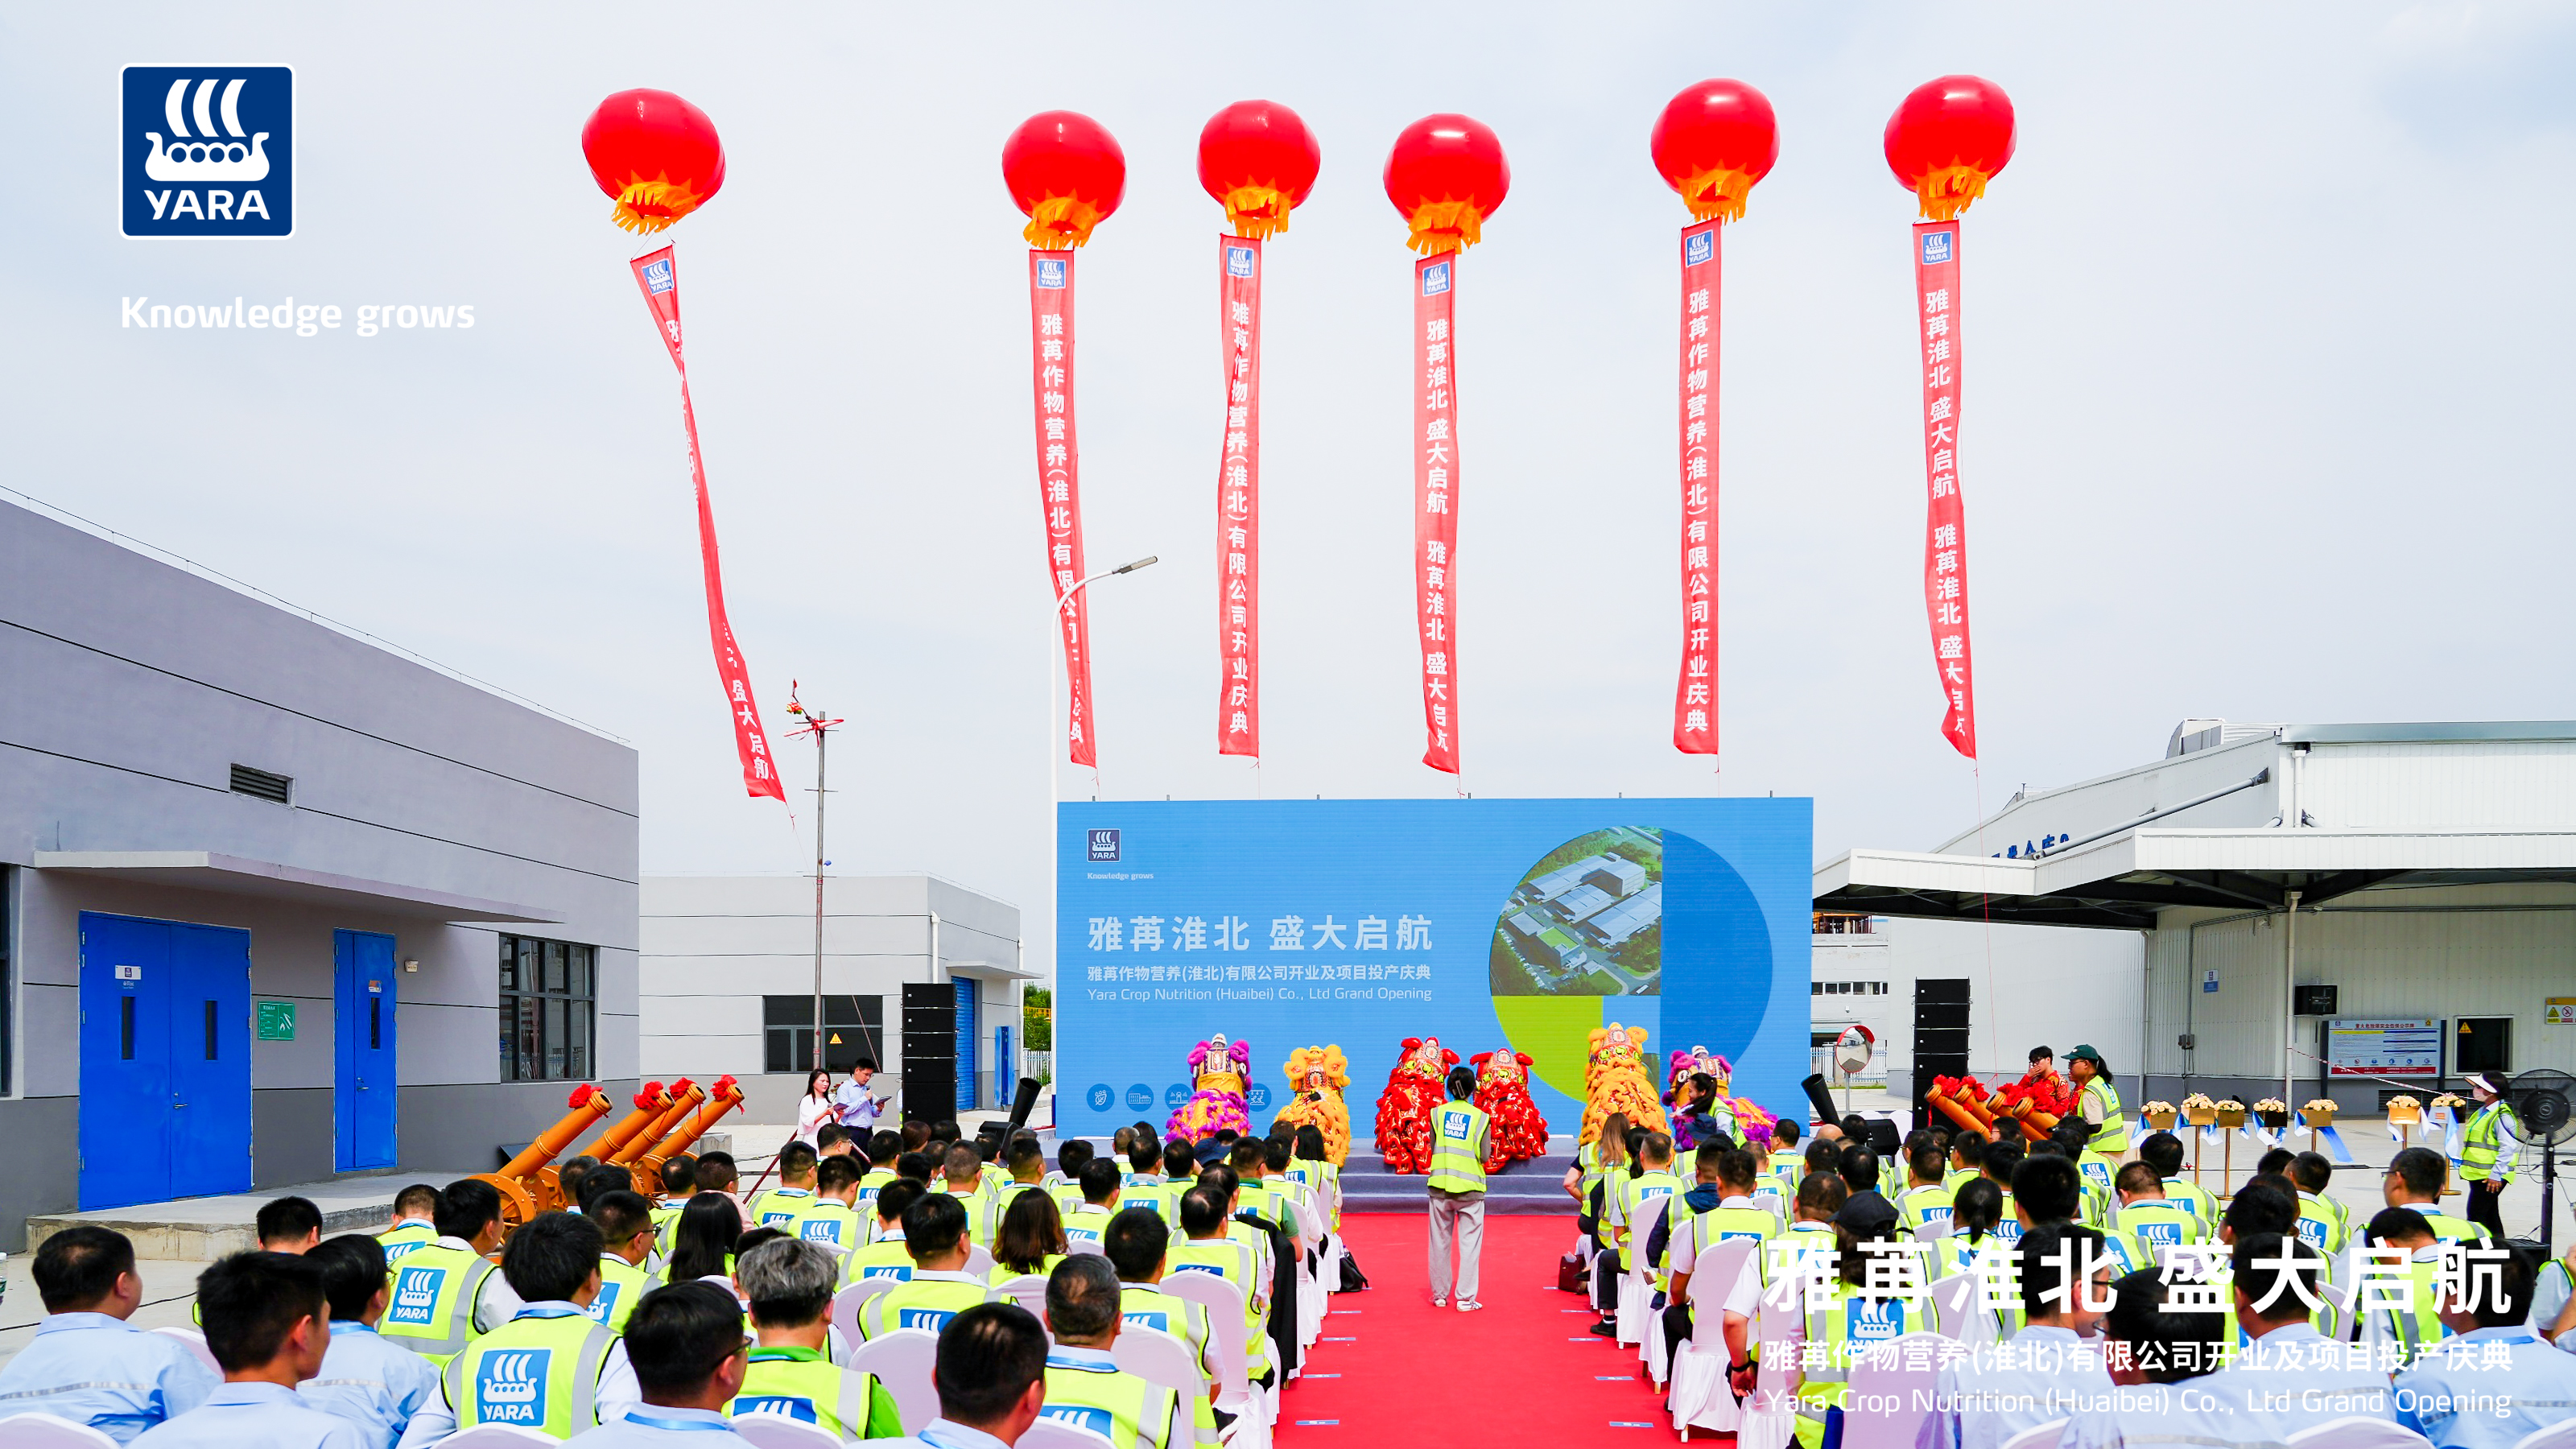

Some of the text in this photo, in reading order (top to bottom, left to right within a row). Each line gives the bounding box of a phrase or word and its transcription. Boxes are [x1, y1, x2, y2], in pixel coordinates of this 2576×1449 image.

[1689, 252, 1709, 262] YARA
[1926, 252, 1947, 262] YARA
[1230, 266, 1249, 275] YARA
[650, 281, 673, 291] YARA
[1041, 279, 1062, 287] YARA
[1426, 283, 1447, 293] YARA
[1926, 289, 1951, 389] 雅苒淮北
[1426, 319, 1448, 411] 雅苒淮北
[1930, 396, 1955, 499] 盛大启航
[1426, 419, 1448, 514] 盛大启航
[1934, 523, 1962, 625] 雅苒淮北
[1426, 540, 1446, 641] 雅苒淮北
[1092, 852, 1116, 860] YARA
[1088, 872, 1154, 881] Knowledge grows
[1088, 914, 1432, 952] 雅苒淮北 盛大启航
[1088, 964, 1431, 983] 雅苒作物营养(淮北)有限公司开业及项目投产庆典
[1087, 988, 1433, 1003] Yara Crop Nutrition (Huaibei) Co., Ltd Grand Opening
[1444, 1129, 1464, 1138] YARA
[395, 1307, 428, 1320] YARA
[483, 1404, 535, 1421] YARA
